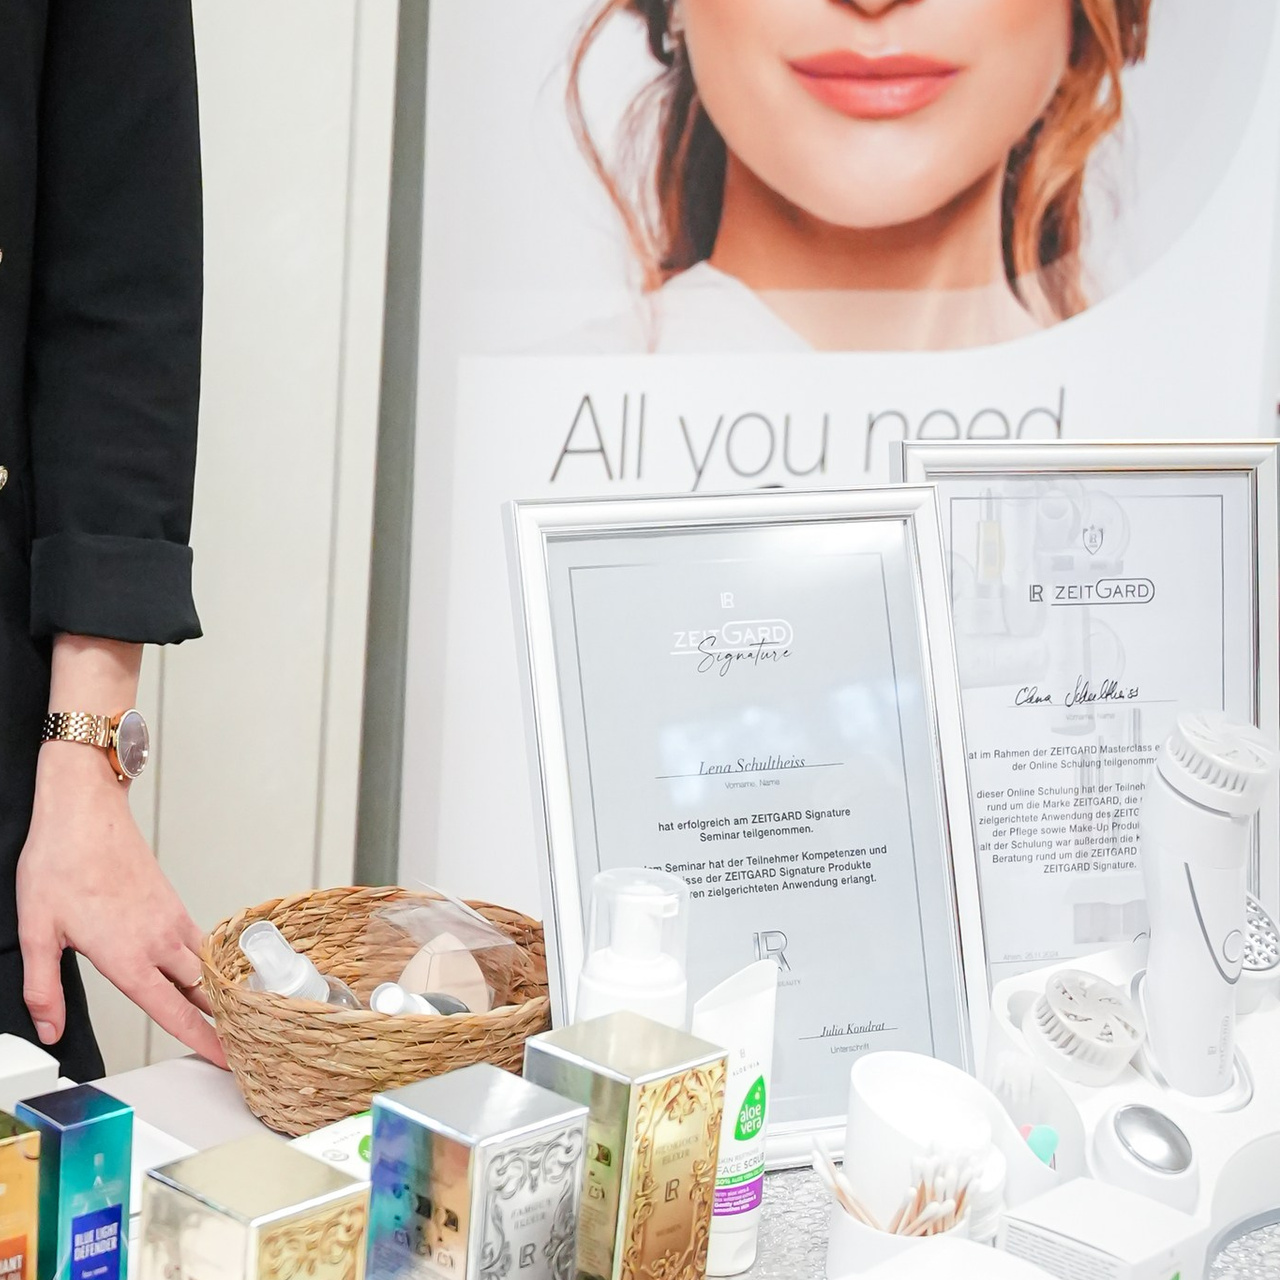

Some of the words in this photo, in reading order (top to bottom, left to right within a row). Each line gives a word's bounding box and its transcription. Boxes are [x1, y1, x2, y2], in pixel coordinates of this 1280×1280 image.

[549, 392, 647, 483] All
[678, 410, 831, 494] you
[1052, 577, 1156, 606] ZEITGARD
[671, 618, 794, 653] ZEITGARD
[696, 634, 793, 677] Signature
[968, 750, 978, 760] at
[980, 750, 991, 760] im
[994, 748, 1031, 759] Rahmen
[1032, 747, 1047, 758] der
[1049, 745, 1098, 757] ZEITGARD
[1099, 743, 1153, 755] Masterclass
[697, 760, 732, 776] Lena
[734, 754, 806, 773] Schultheiss
[1011, 761, 1027, 772] der
[1029, 760, 1058, 771] Online
[1060, 758, 1102, 770] Schulung
[976, 788, 1005, 799] dieser
[1006, 786, 1036, 798] Online
[1037, 785, 1080, 797] Schulung
[1081, 783, 1097, 795] hat
[1097, 783, 1113, 794] der
[1114, 781, 1146, 793] Teilneh
[986, 801, 1008, 812] rund
[1009, 801, 1025, 811] um
[1026, 800, 1041, 810] die
[1042, 798, 1071, 810] Marke
[1072, 795, 1123, 808] ZEITGARD,
[1123, 794, 1138, 805] die
[657, 821, 675, 833] hat
[677, 817, 731, 832] erfolgreich
[733, 816, 749, 826] am
[750, 810, 803, 825] ZEITGARD
[805, 807, 852, 822] Signature
[978, 814, 1039, 825] zielgerichtete
[1040, 811, 1094, 823] Anwendung
[1095, 810, 1112, 820] des
[699, 828, 741, 843] Seminar
[742, 824, 815, 841] teilgenommen.
[991, 827, 1008, 838] der
[1008, 826, 1039, 838] Pflege
[1040, 825, 1067, 835] sowie
[1068, 822, 1110, 834] Make-Up
[1111, 821, 1140, 833] Produ
[993, 840, 1009, 851] der
[1010, 838, 1054, 851] Schulung
[1054, 837, 1072, 848] war
[1073, 834, 1118, 847] außerdem
[1118, 833, 1134, 844] die
[664, 860, 707, 874] Seminar
[708, 858, 726, 870] hat
[727, 857, 744, 869] der
[746, 851, 800, 867] Teilnehmer
[801, 846, 868, 863] Kompetenzen
[869, 844, 888, 856] und
[991, 852, 1034, 865] Beratung
[1034, 851, 1057, 862] rund
[1058, 851, 1073, 861] um
[1074, 848, 1089, 859] die
[1090, 845, 1138, 858] ZEITGARD
[705, 871, 722, 885] der
[724, 867, 777, 883] ZEITGARD
[778, 862, 826, 879] Signature
[827, 859, 872, 874] Produkte
[1043, 862, 1091, 875] ZEITGARD
[1092, 859, 1138, 873] Signature.
[689, 888, 706, 900] ren
[707, 881, 780, 899] zielgerichteten
[781, 877, 839, 892] Anwendung
[840, 872, 878, 888] erlangt.
[819, 1024, 845, 1038] Julia
[845, 1020, 887, 1036] Kondrat
[739, 1103, 762, 1123] aloe
[739, 1118, 762, 1136] vera
[73, 1229, 95, 1248] BLUE
[95, 1221, 120, 1241] LIGHT
[73, 1236, 119, 1262] DEFENDER
